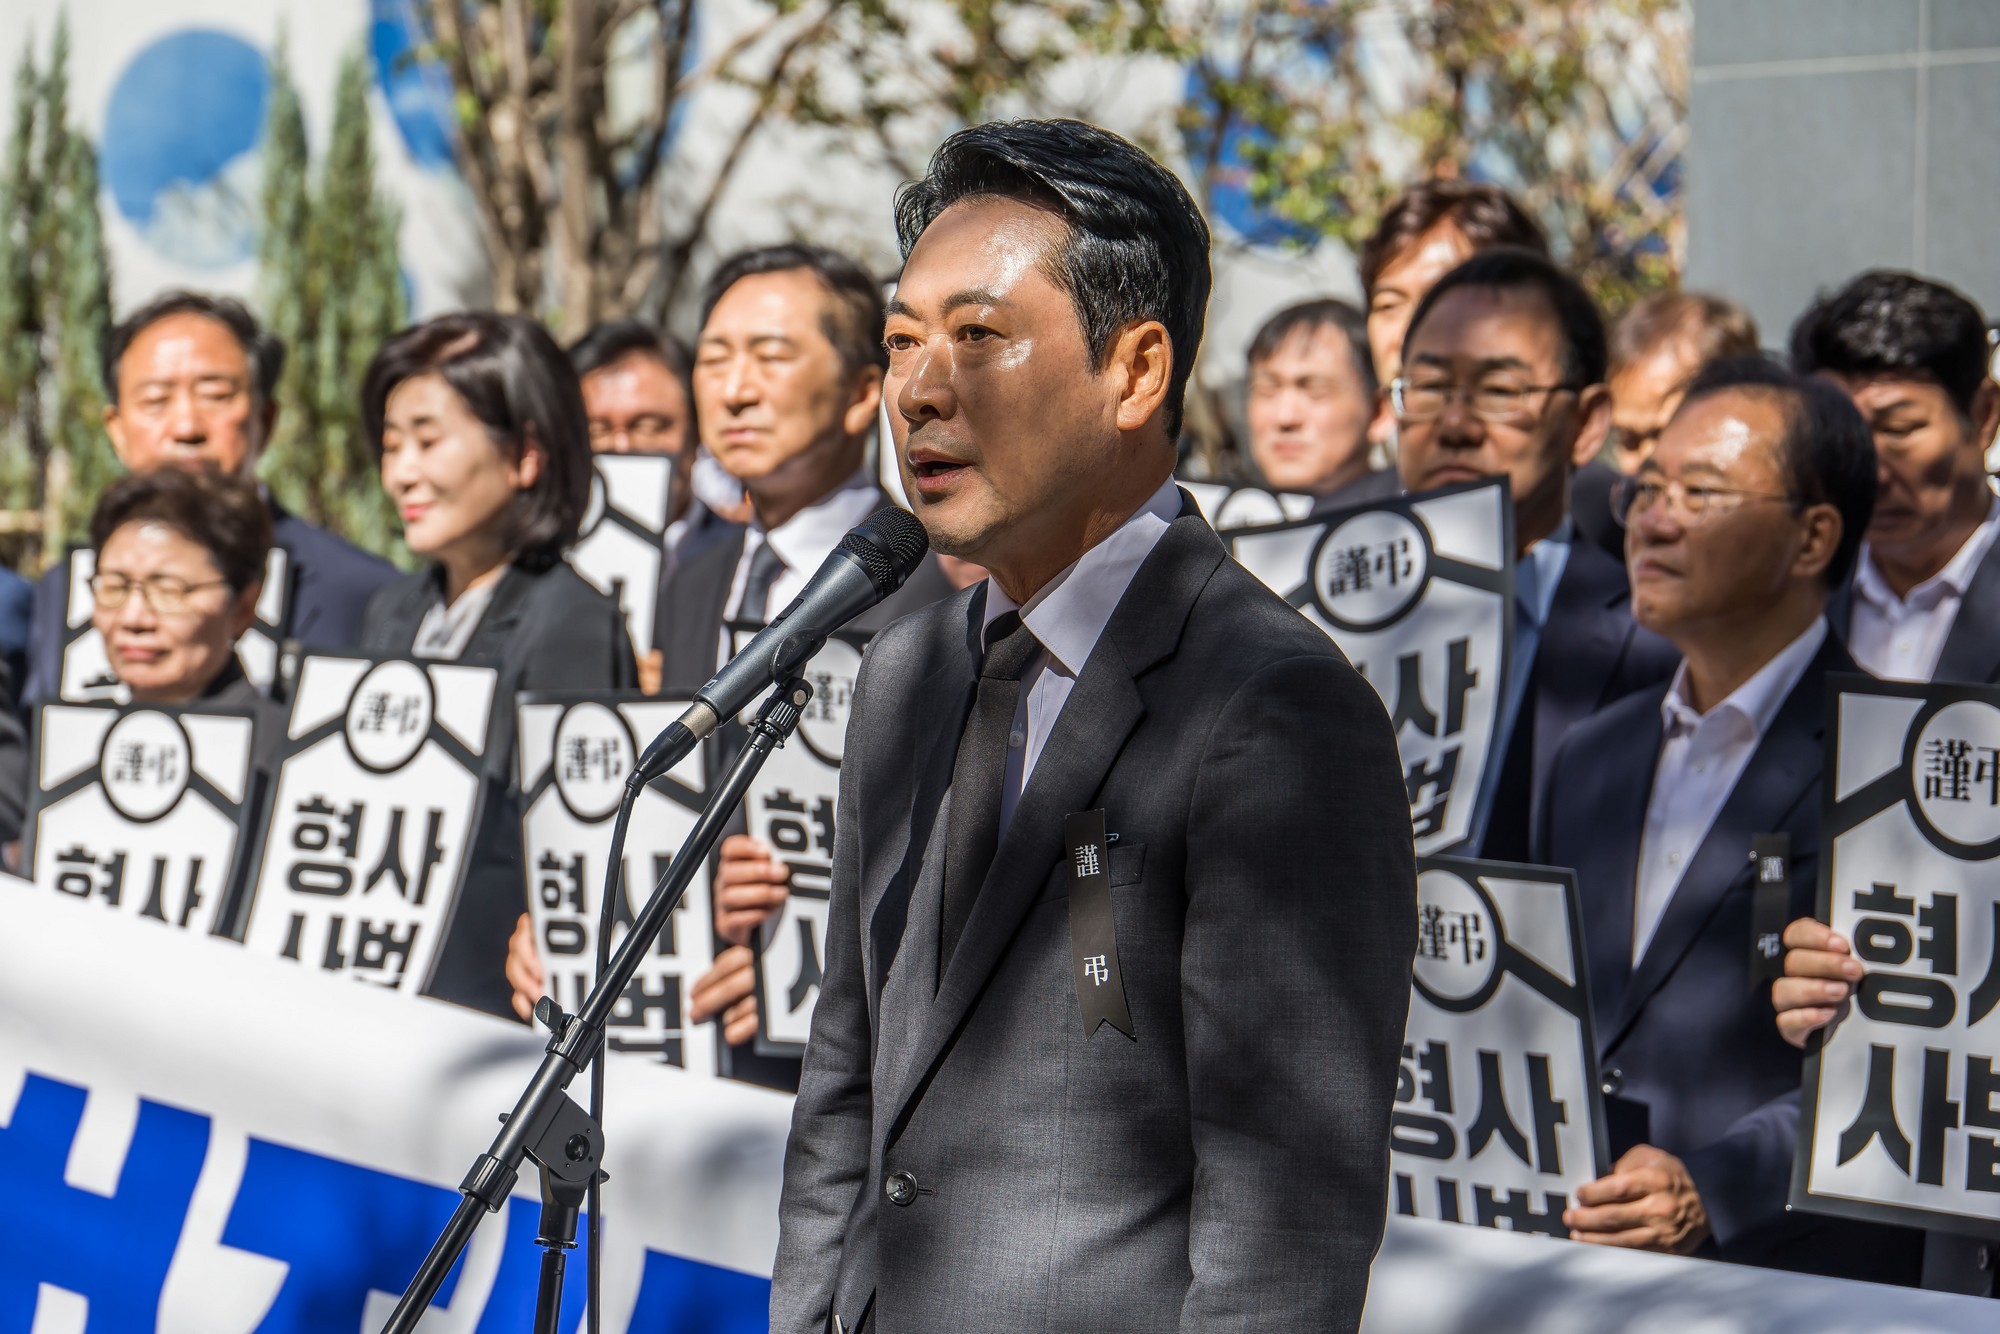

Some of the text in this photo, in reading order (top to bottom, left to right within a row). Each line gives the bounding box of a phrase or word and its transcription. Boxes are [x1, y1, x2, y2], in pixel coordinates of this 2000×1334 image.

[1329, 537, 1414, 598] 謹弔
[290, 794, 445, 906] 형사
[764, 789, 836, 900] 형
[1853, 881, 2000, 1029] 형
